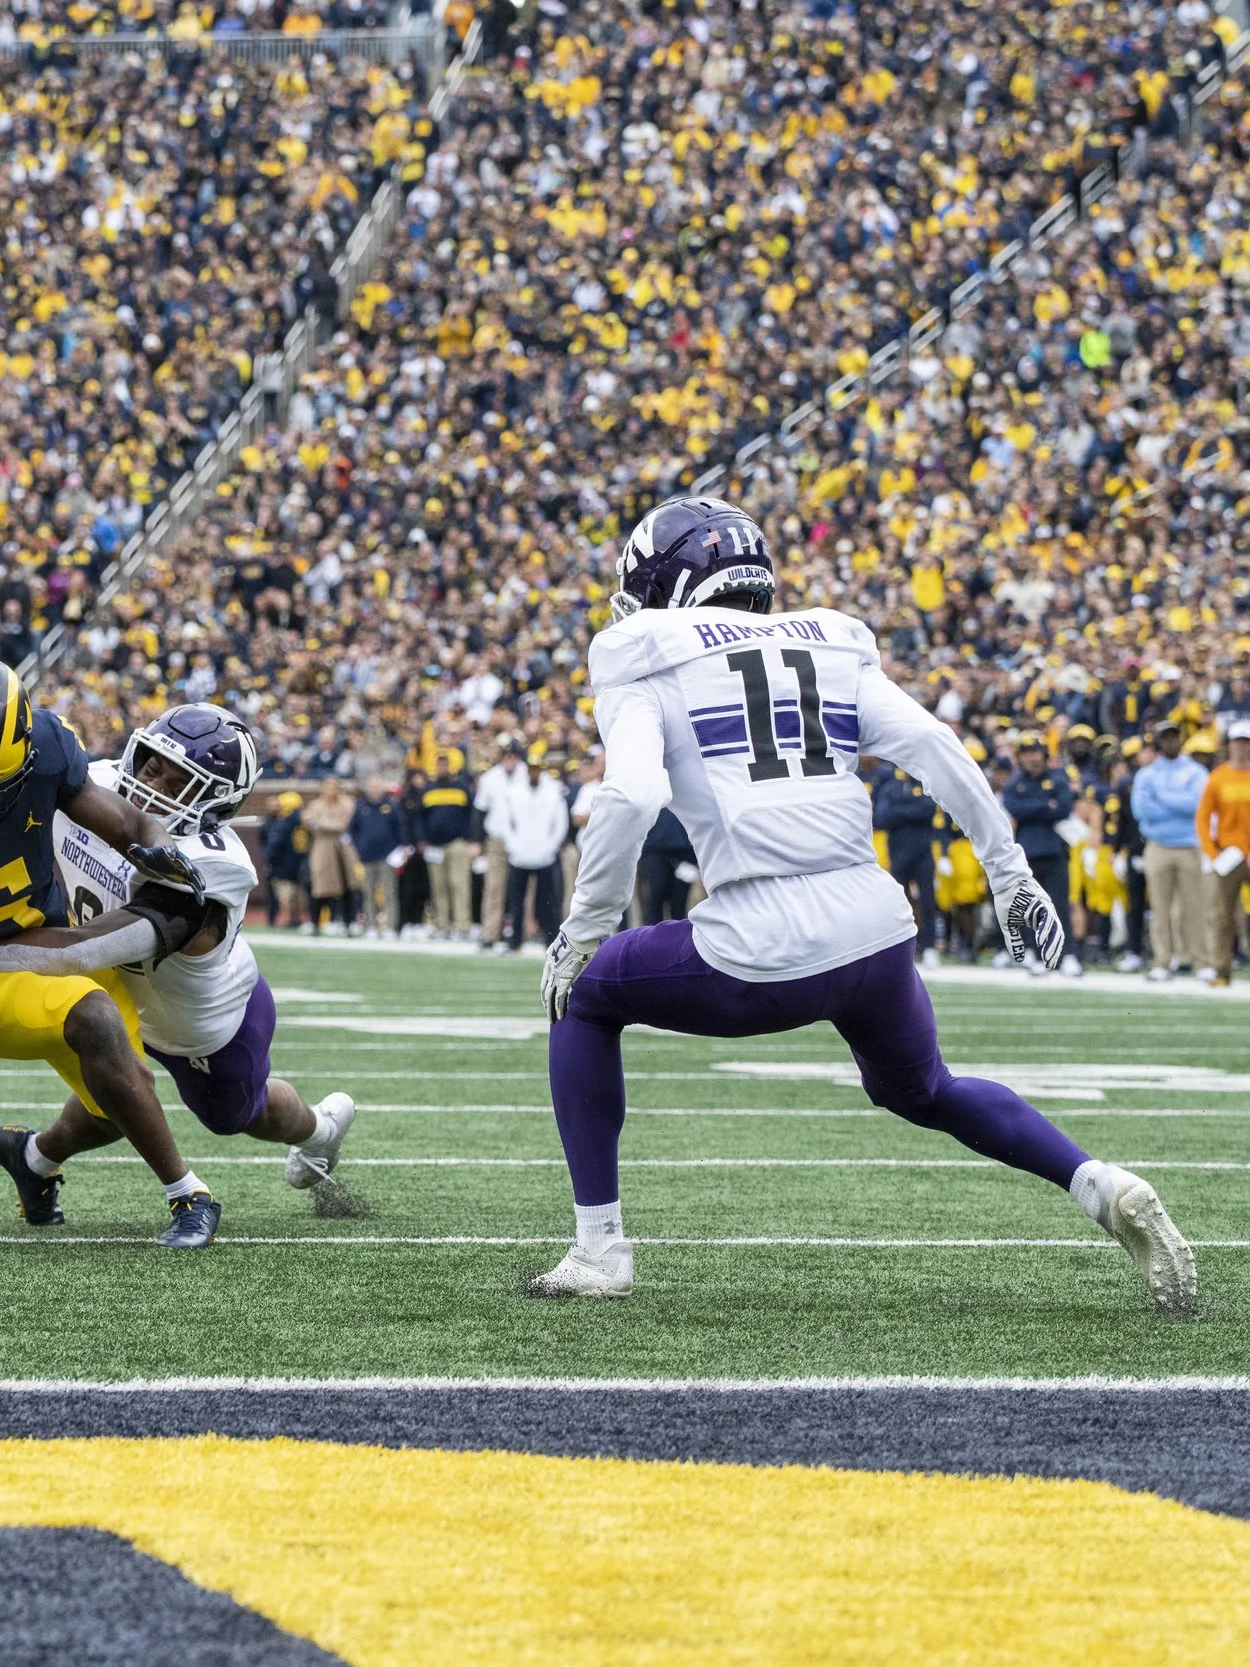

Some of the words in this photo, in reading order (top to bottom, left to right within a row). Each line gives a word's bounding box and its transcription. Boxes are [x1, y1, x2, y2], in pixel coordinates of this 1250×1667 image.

[726, 527, 758, 555] 11
[727, 566, 768, 582] WILDCATS
[693, 620, 828, 649] HAMPTON
[726, 648, 838, 783] 11
[60, 836, 128, 904] NORTHWESTERN
